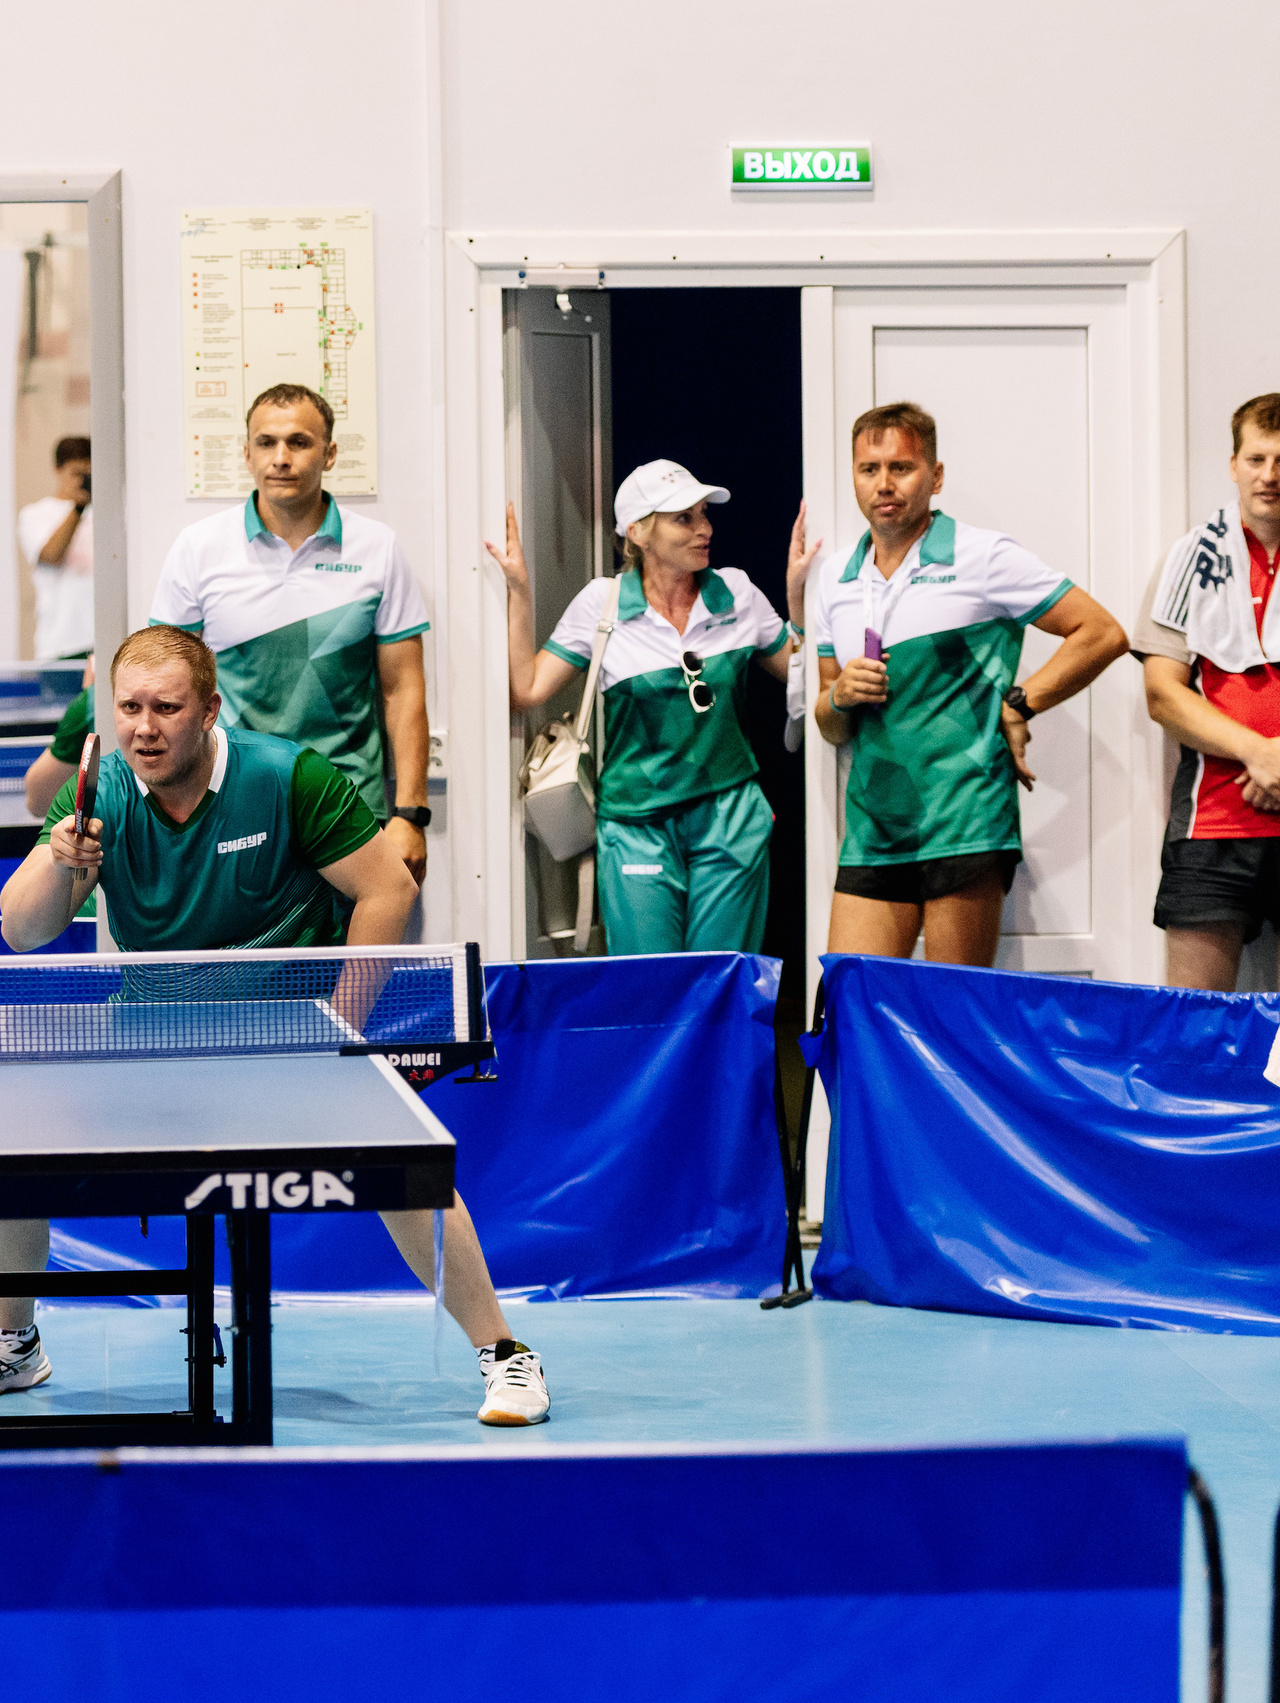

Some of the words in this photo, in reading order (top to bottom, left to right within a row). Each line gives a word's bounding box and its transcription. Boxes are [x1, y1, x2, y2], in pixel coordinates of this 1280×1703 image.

[744, 151, 860, 180] ВЫХОД
[315, 563, 362, 573] СИБУР
[217, 831, 267, 854] СИБУР
[387, 1053, 441, 1066] DAWEI
[185, 1170, 355, 1210] STIGA
